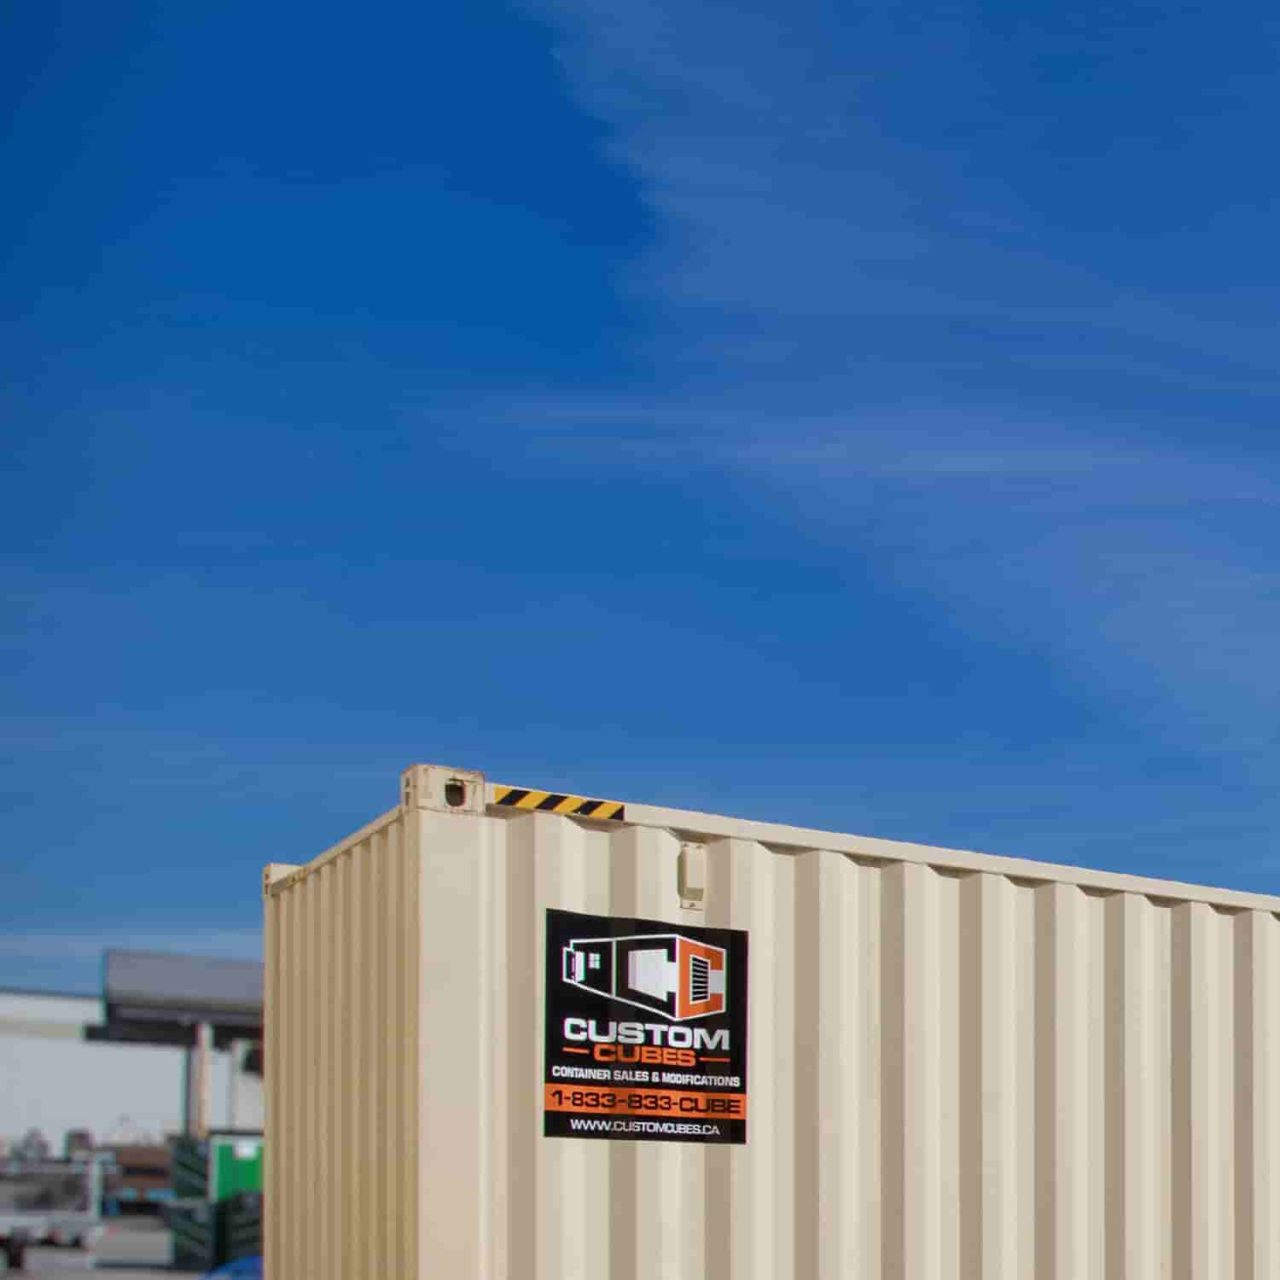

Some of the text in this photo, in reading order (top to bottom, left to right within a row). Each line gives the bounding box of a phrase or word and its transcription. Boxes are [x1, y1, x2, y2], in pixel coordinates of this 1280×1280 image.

[564, 1017, 730, 1050] CUSTOM
[593, 1043, 696, 1067] CUBES
[552, 1066, 740, 1088] CONTAINER SALES & MODIFICATIONS
[552, 1090, 741, 1114] 1-833-833-CUBE
[570, 1118, 721, 1136] WWW.CUSTOMCUBES.CA
